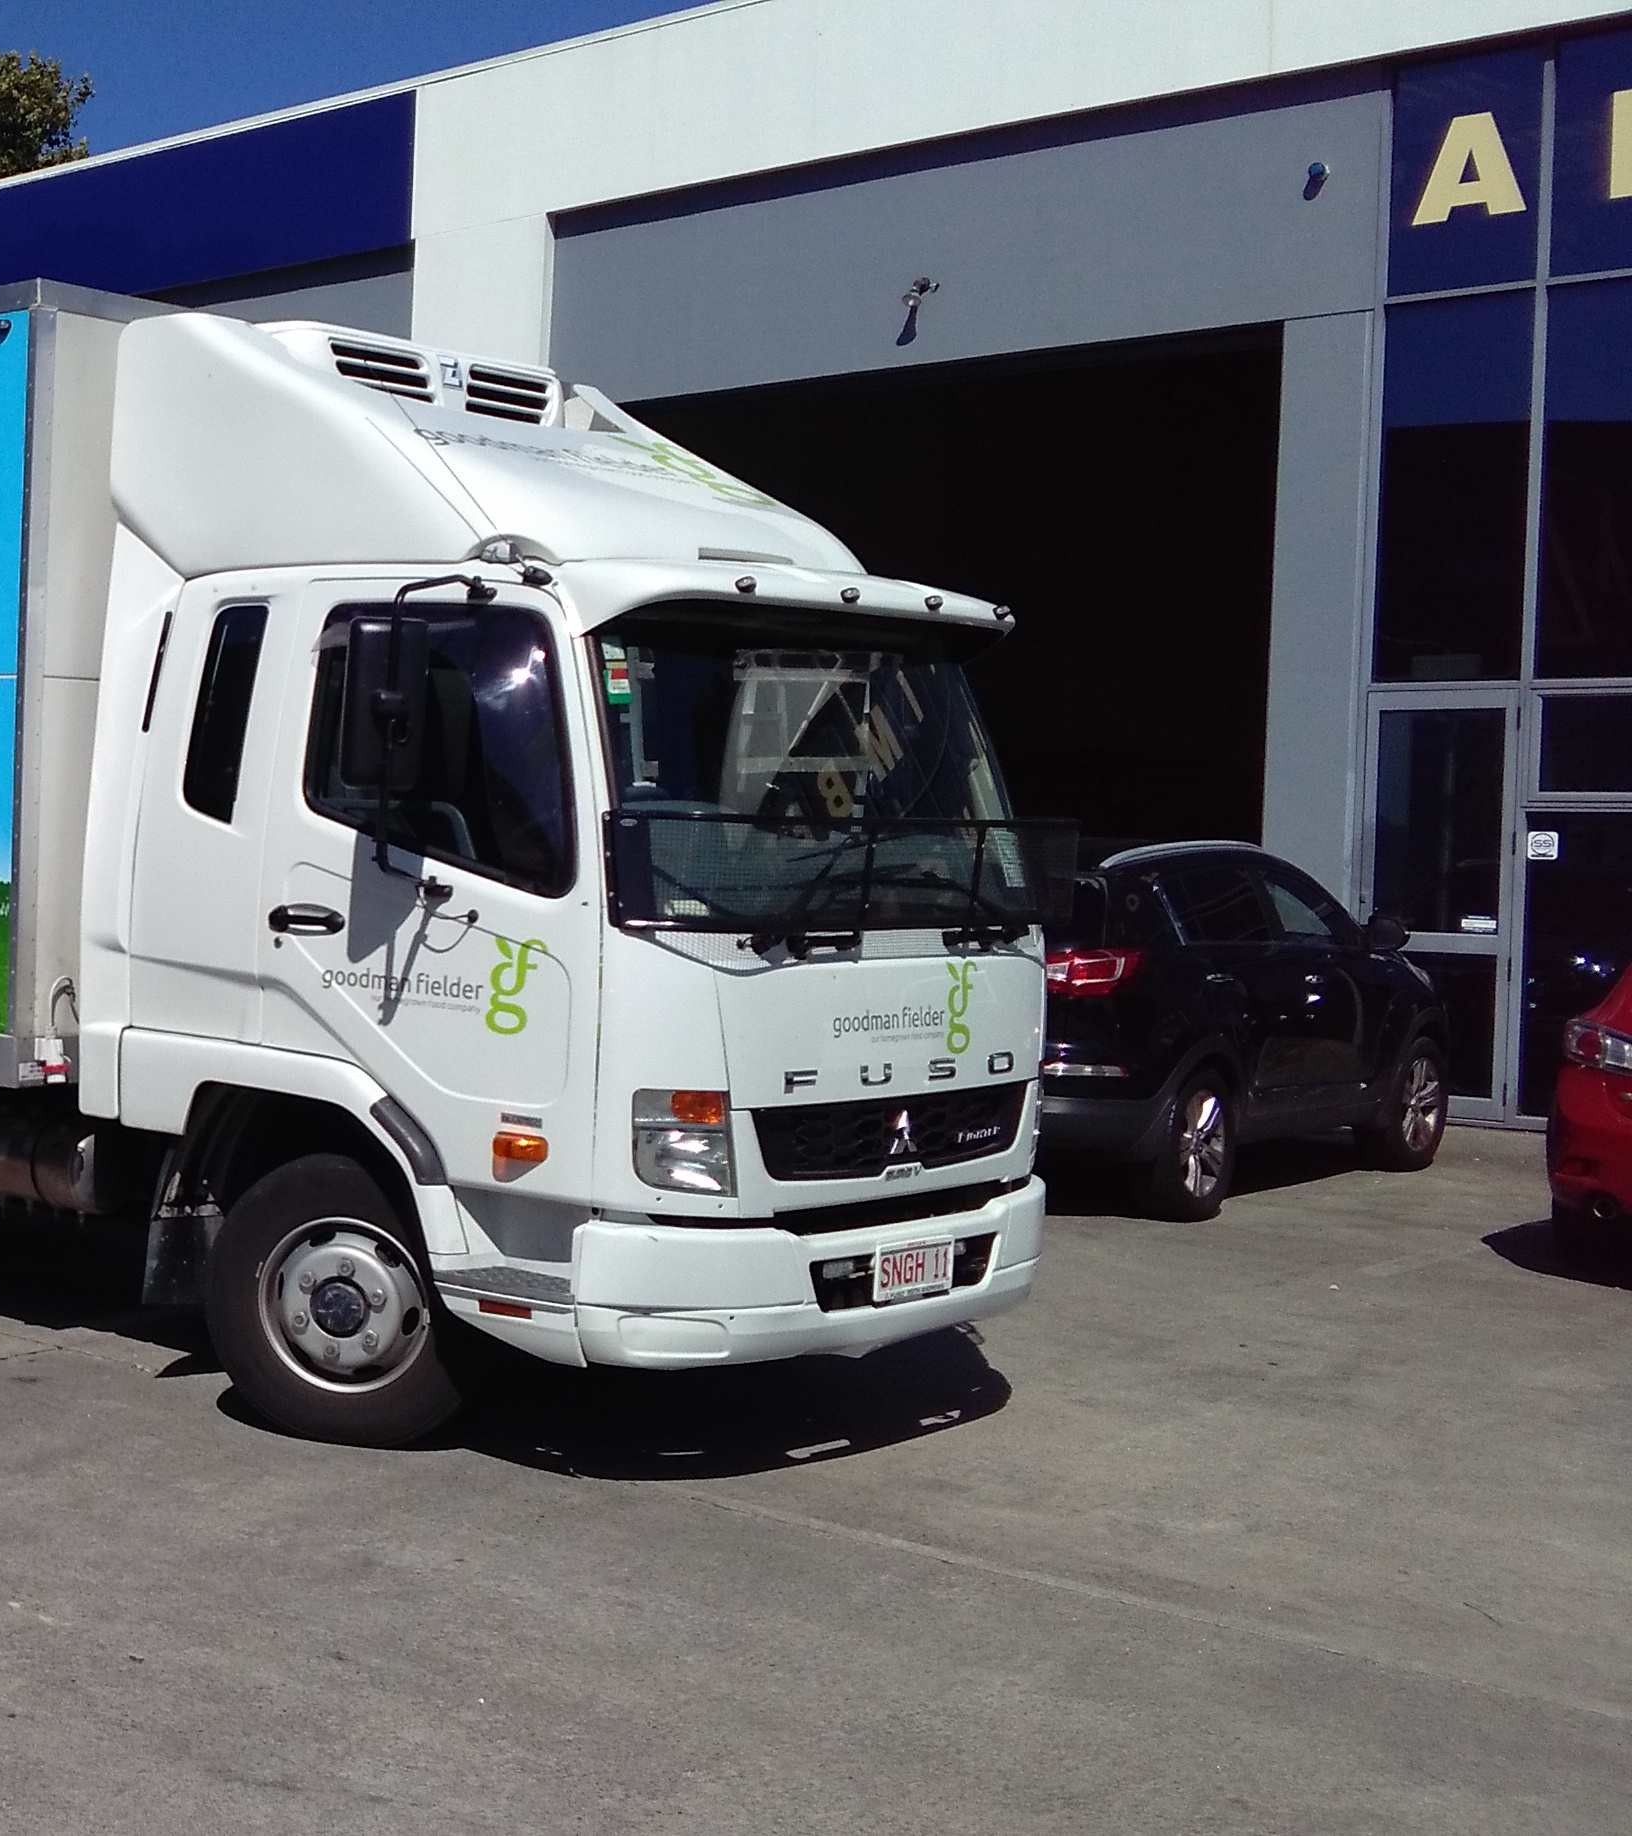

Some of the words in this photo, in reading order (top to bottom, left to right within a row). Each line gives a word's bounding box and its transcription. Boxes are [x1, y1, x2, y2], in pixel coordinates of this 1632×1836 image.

[322, 968, 412, 993] goodman
[416, 973, 484, 1000] fielder
[833, 1010, 900, 1038] goodman
[902, 1006, 945, 1029] fielder
[783, 1050, 1015, 1095] FUSO
[880, 1251, 926, 1288] SNGH
[933, 1247, 948, 1279] 11
